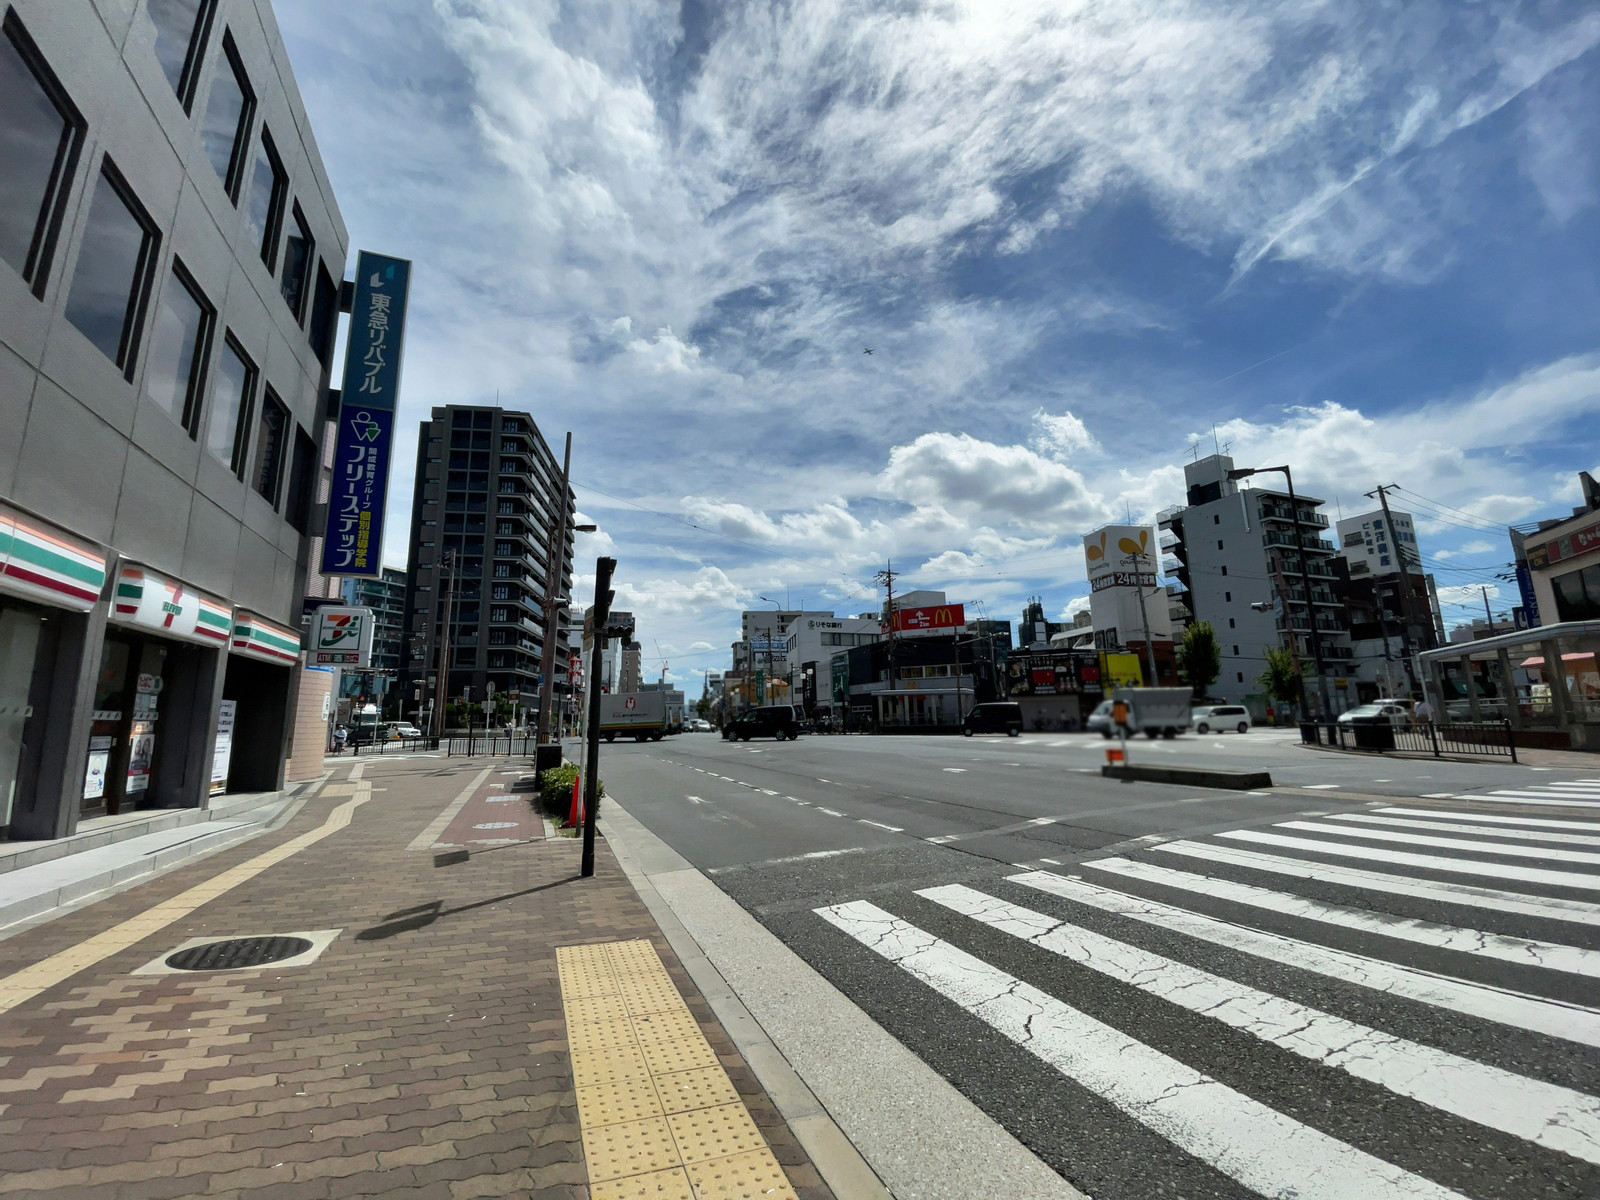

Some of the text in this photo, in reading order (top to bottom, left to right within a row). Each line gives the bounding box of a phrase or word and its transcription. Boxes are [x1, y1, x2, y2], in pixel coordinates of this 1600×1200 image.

[359, 292, 392, 395] 東急リバブル
[334, 444, 365, 567] フリーステップ
[362, 447, 378, 508] 開成教育グループ
[354, 510, 371, 568] 個別指導学院
[1117, 572, 1155, 585] 24時営業
[815, 620, 843, 629] りそな銀行
[318, 654, 331, 662] ATM
